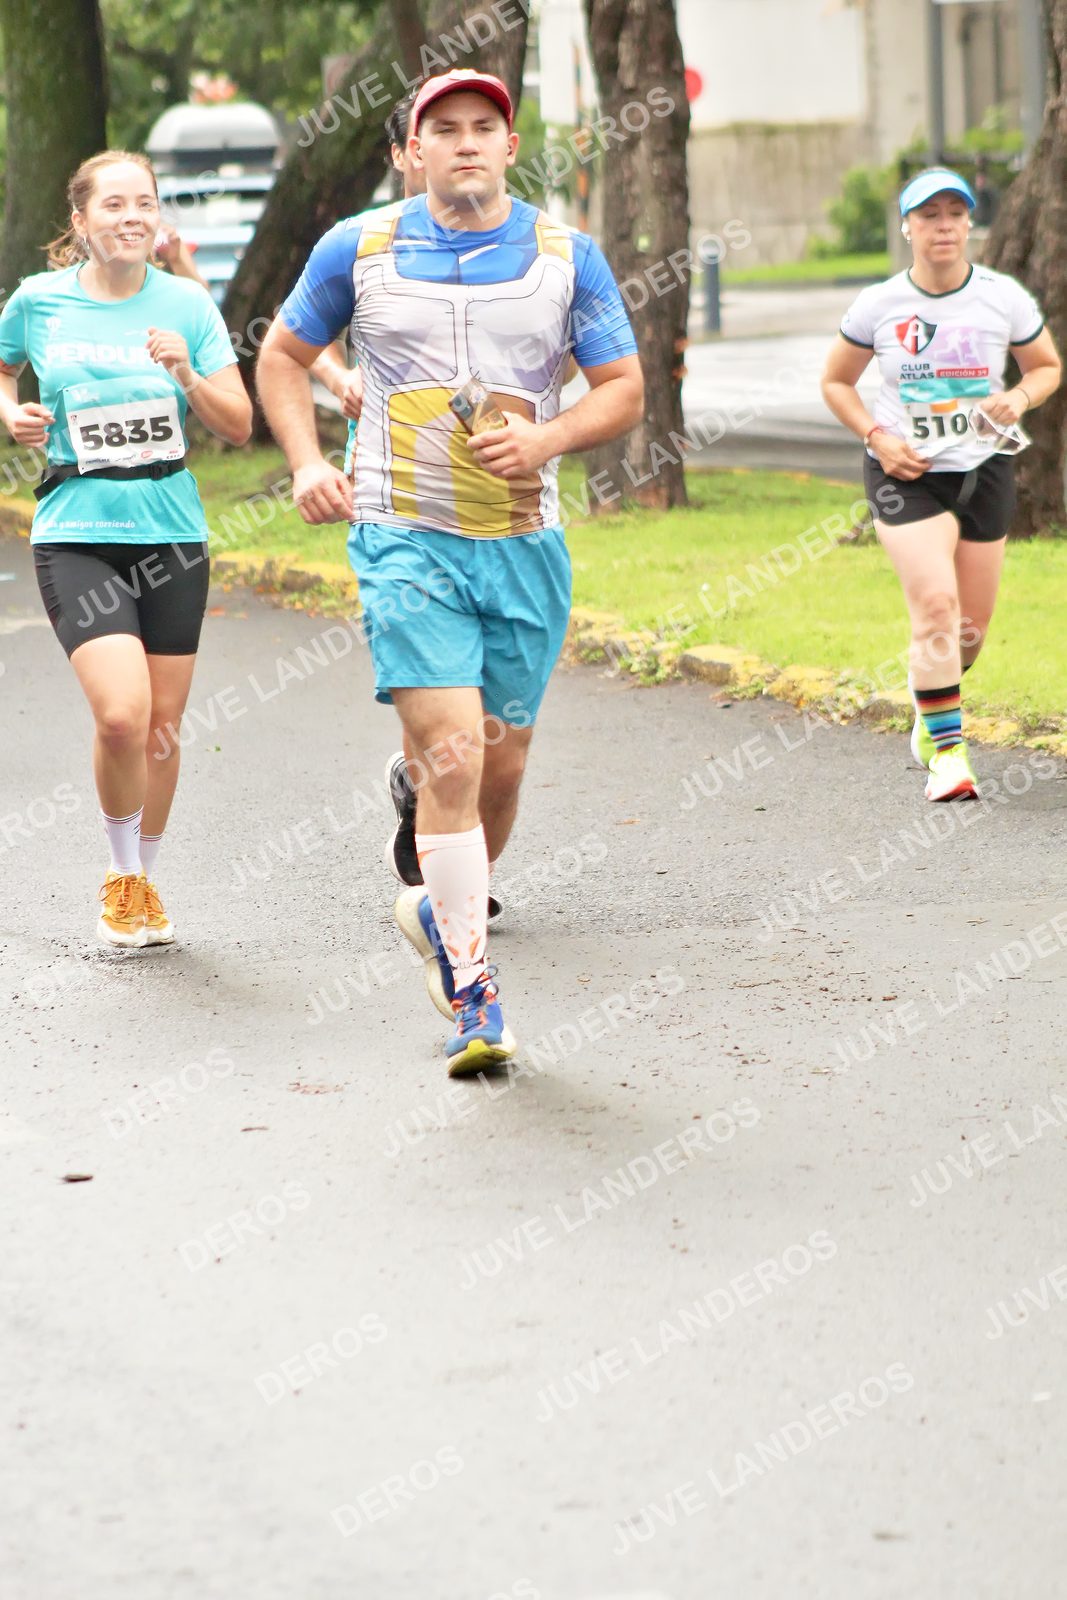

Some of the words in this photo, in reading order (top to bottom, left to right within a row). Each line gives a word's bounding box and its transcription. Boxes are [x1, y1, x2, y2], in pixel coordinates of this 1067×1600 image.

[46, 344, 155, 366] PERDUR
[901, 363, 930, 371] CLUB
[900, 371, 935, 380] ATLAS
[80, 416, 173, 450] 5835
[912, 413, 976, 439] 510
[95, 519, 136, 529] corriendo
